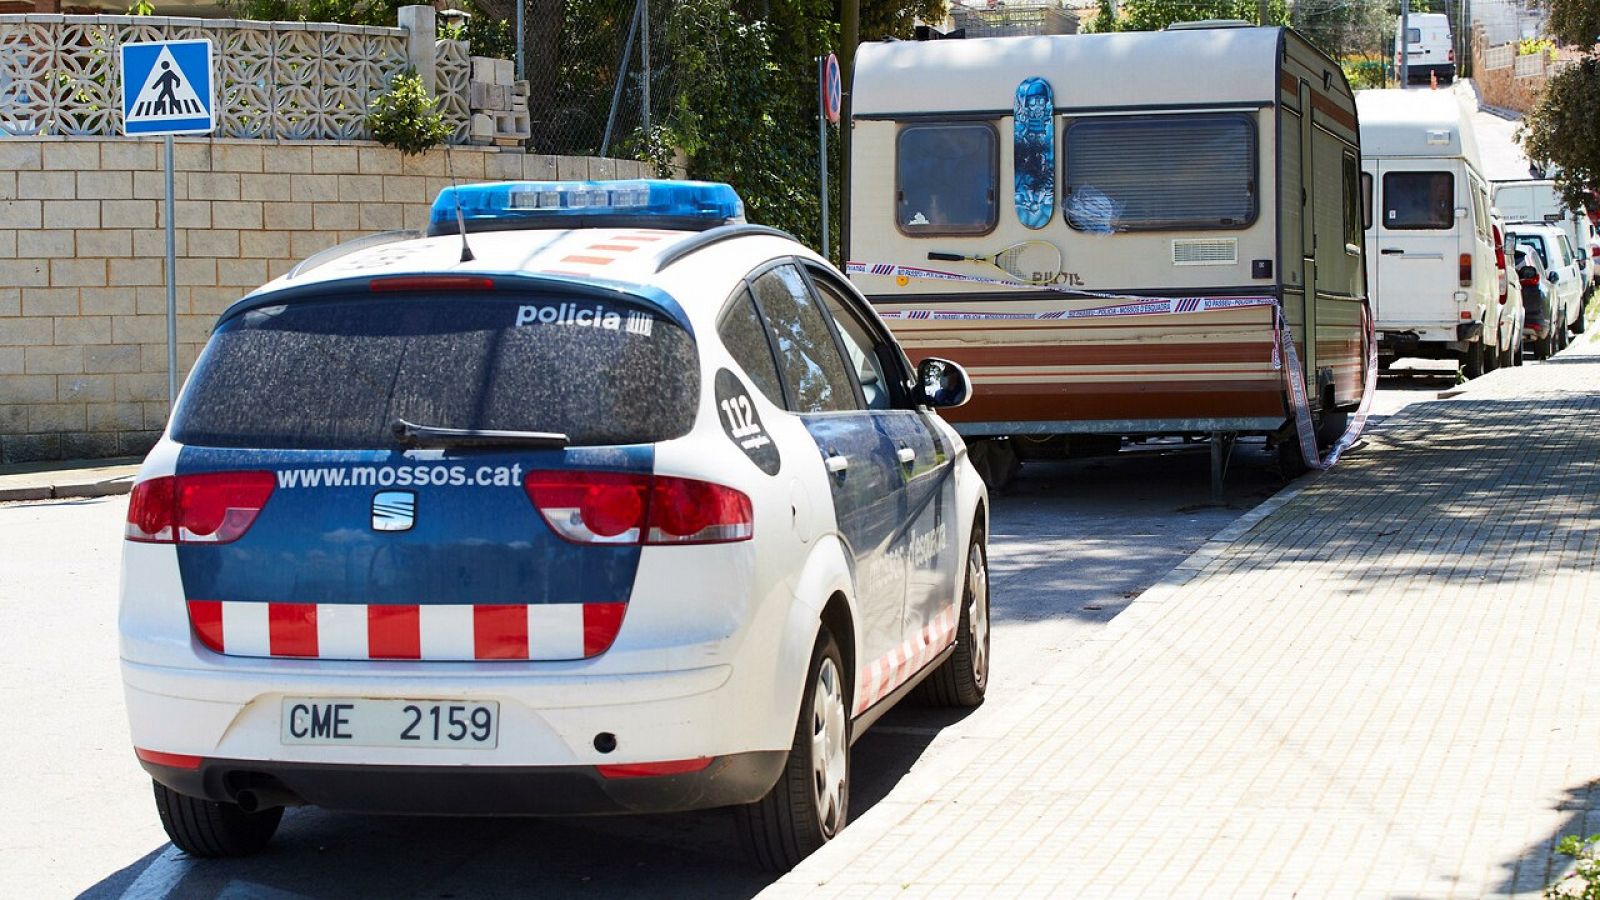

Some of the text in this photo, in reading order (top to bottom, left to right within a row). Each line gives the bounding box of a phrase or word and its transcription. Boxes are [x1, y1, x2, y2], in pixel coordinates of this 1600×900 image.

[516, 304, 621, 330] policia
[720, 395, 761, 438] 112
[277, 462, 523, 489] www.mossos.cat
[289, 703, 492, 742] CME 2159
